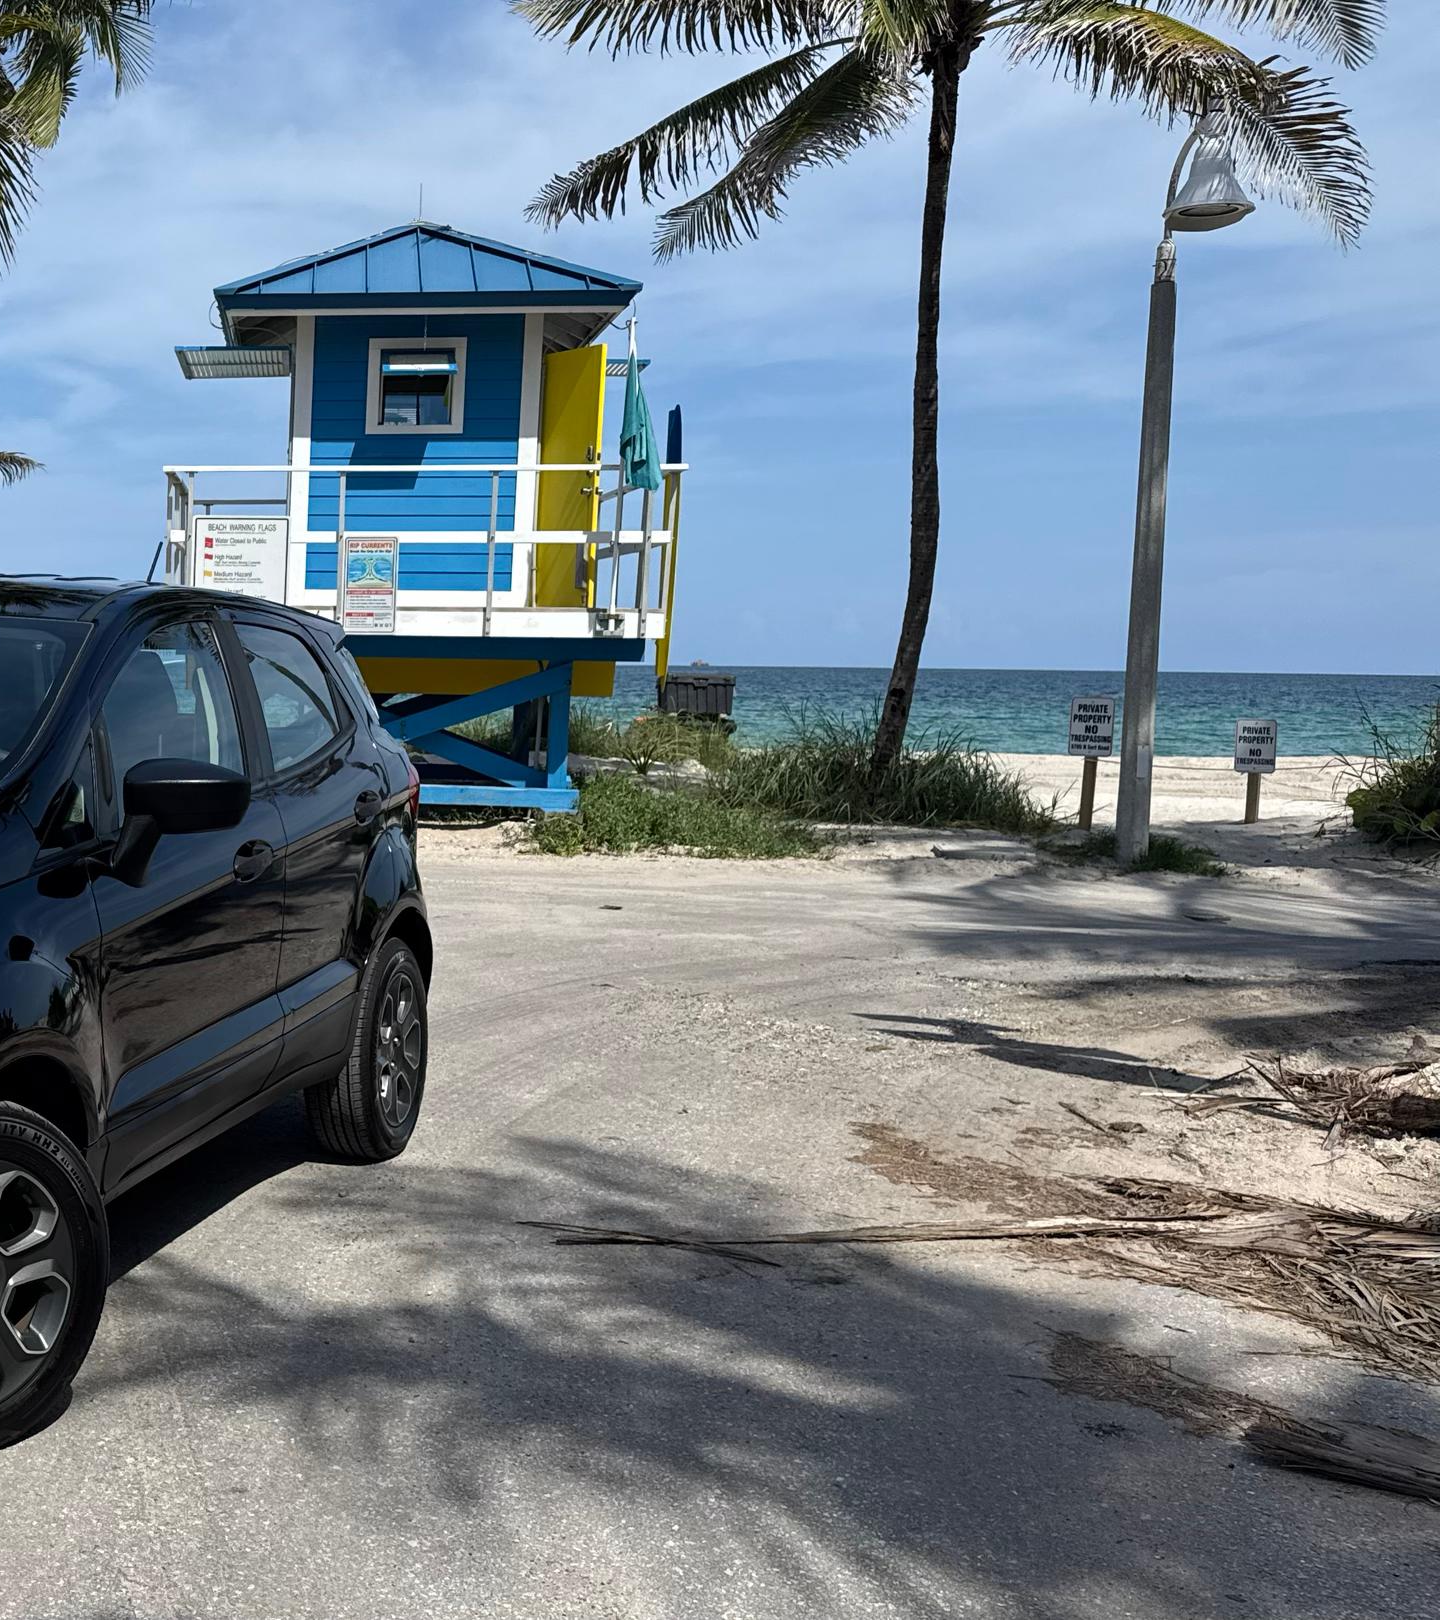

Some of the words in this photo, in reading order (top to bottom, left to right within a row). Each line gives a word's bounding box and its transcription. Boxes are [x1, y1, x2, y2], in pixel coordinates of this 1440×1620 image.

[207, 523, 227, 532] BEACH
[229, 523, 256, 532] WARNING
[258, 523, 277, 532] FLAGS
[1078, 704, 1109, 713] PRIVATE
[1073, 714, 1112, 724] PROPERTY
[1084, 725, 1099, 734] NO
[1242, 726, 1271, 735] PRIVATE
[1071, 734, 1112, 743] TRESPASSING
[1239, 735, 1274, 744] PROPERTY
[1249, 748, 1262, 757] NO
[1236, 757, 1275, 765] TRESPASSING
[32, 1132, 61, 1156] HH2
